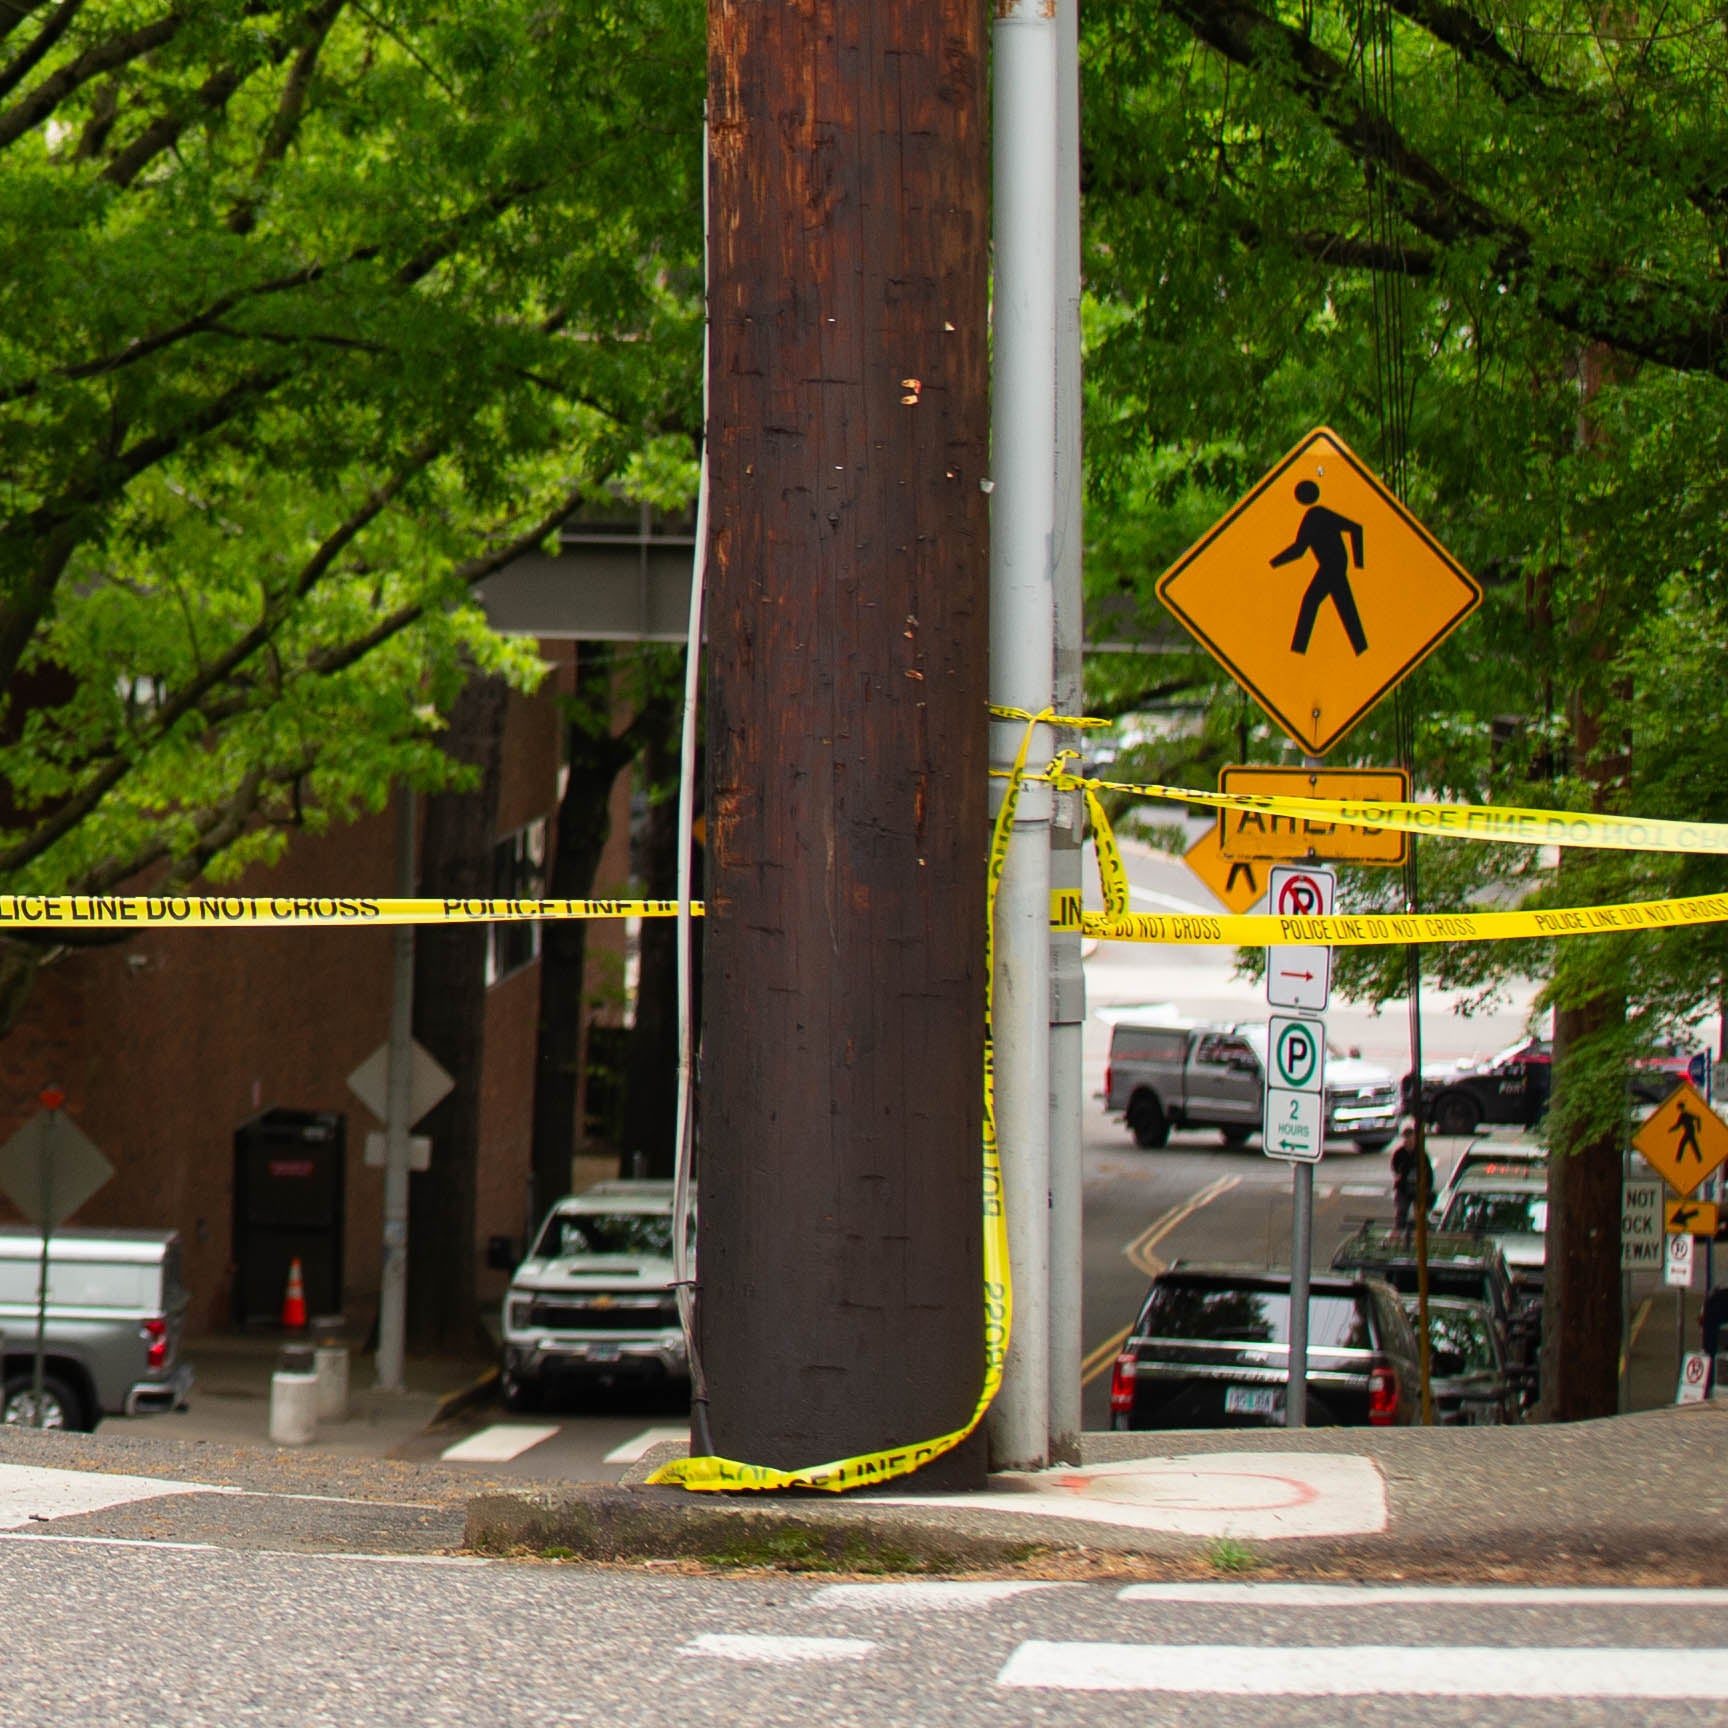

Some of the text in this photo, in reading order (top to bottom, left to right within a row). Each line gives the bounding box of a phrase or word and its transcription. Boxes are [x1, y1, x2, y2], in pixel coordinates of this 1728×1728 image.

[71, 898, 138, 921] LINE
[147, 898, 190, 921] DO
[199, 898, 264, 921] NOT
[273, 899, 380, 921] CROSS
[1535, 898, 1728, 932] POLICE LINE DO NOT CROSS
[1140, 916, 1167, 939] NOT
[1174, 917, 1222, 940] CROSS
[1282, 916, 1476, 940] POLICE LINE DO NOT CROSS
[1289, 1099, 1299, 1120] 2
[1278, 1123, 1310, 1138] HOURS
[1626, 1188, 1656, 1209] NOT
[1622, 1215, 1652, 1234] OCK
[1624, 1240, 1660, 1261] EWAY
